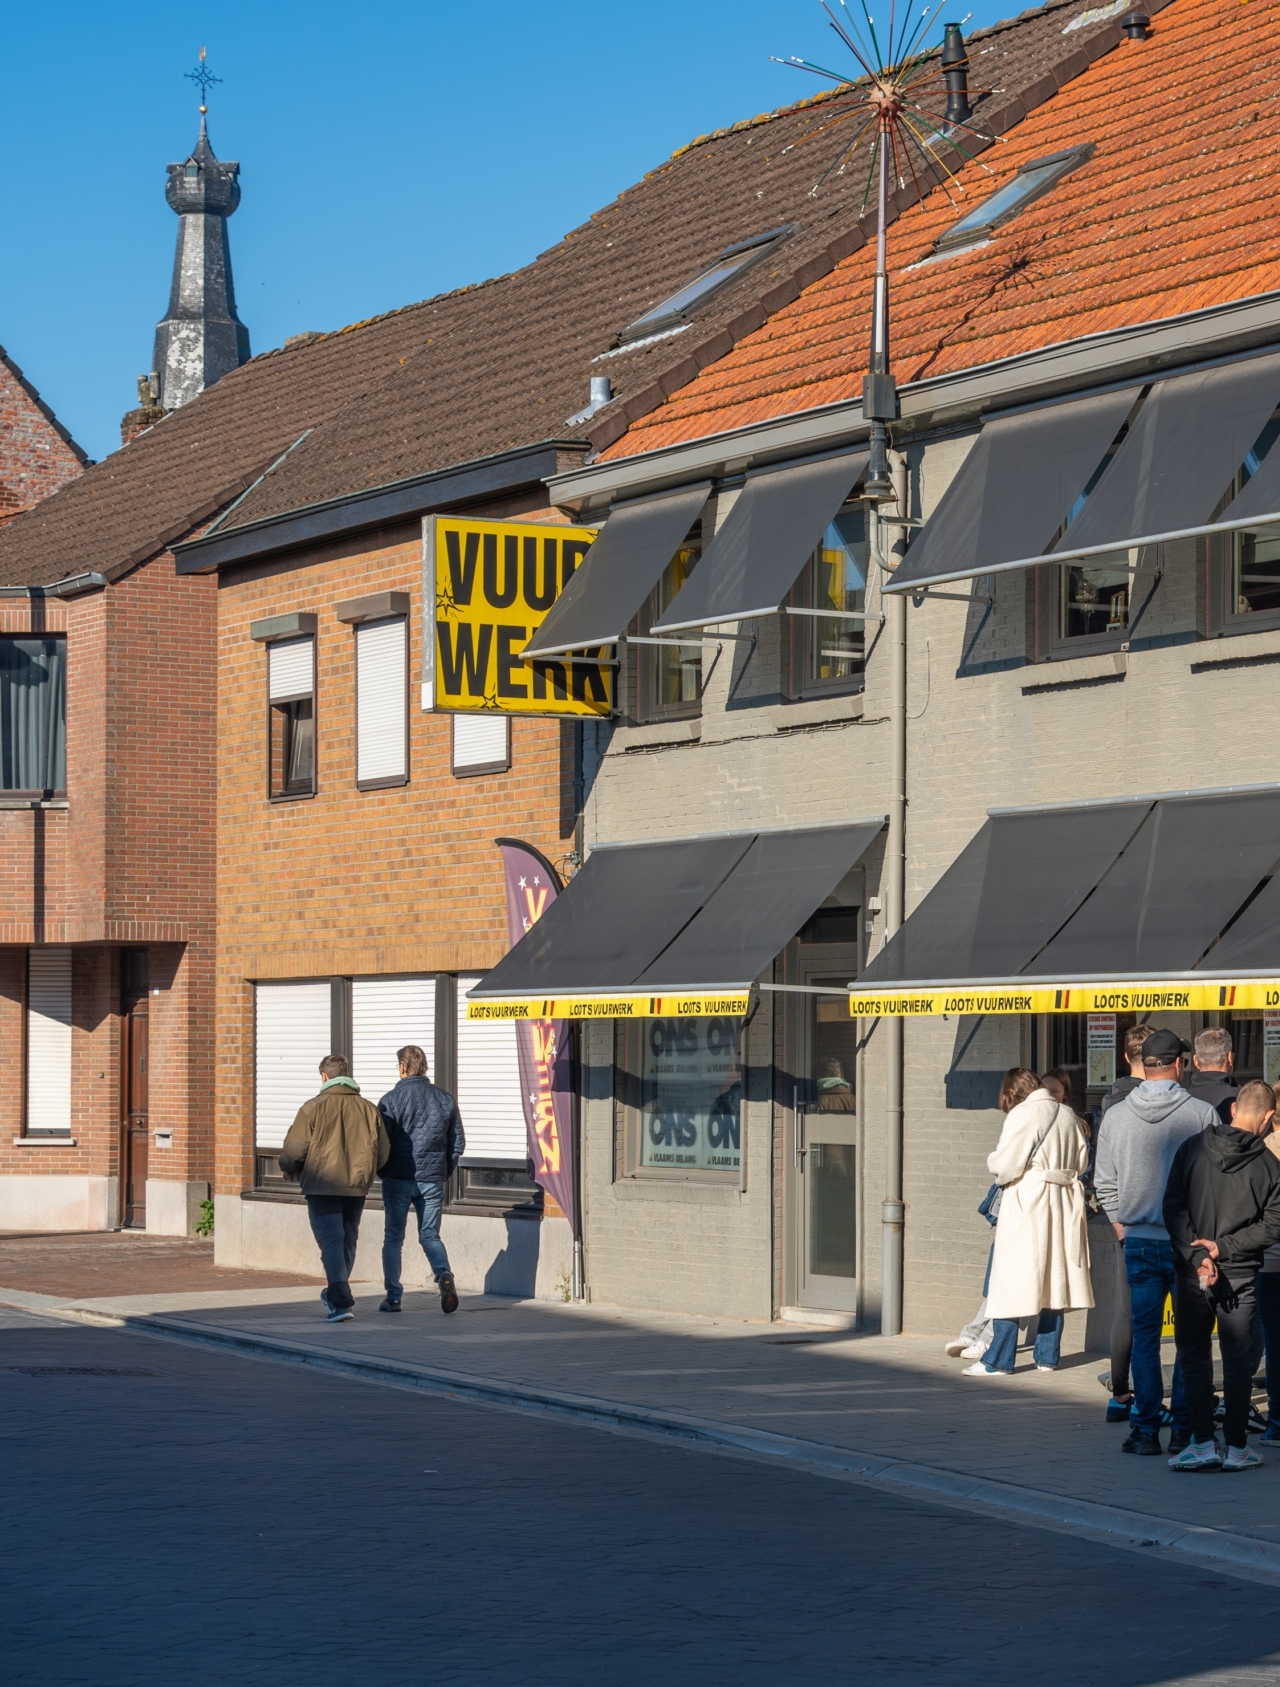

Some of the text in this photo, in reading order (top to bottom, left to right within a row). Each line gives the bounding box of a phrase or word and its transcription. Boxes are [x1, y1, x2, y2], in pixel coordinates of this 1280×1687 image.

[677, 1000, 747, 1014] LOOTS VUURWERK
[852, 999, 934, 1014] LOOTS VUURWERK
[944, 996, 1032, 1012] LOOTS VUURWERK
[1094, 992, 1190, 1009] LOOTS VUURWERK
[649, 1017, 698, 1057] ONS
[707, 1016, 741, 1056] ON
[649, 1108, 697, 1148] ONS
[707, 1109, 741, 1150] ON
